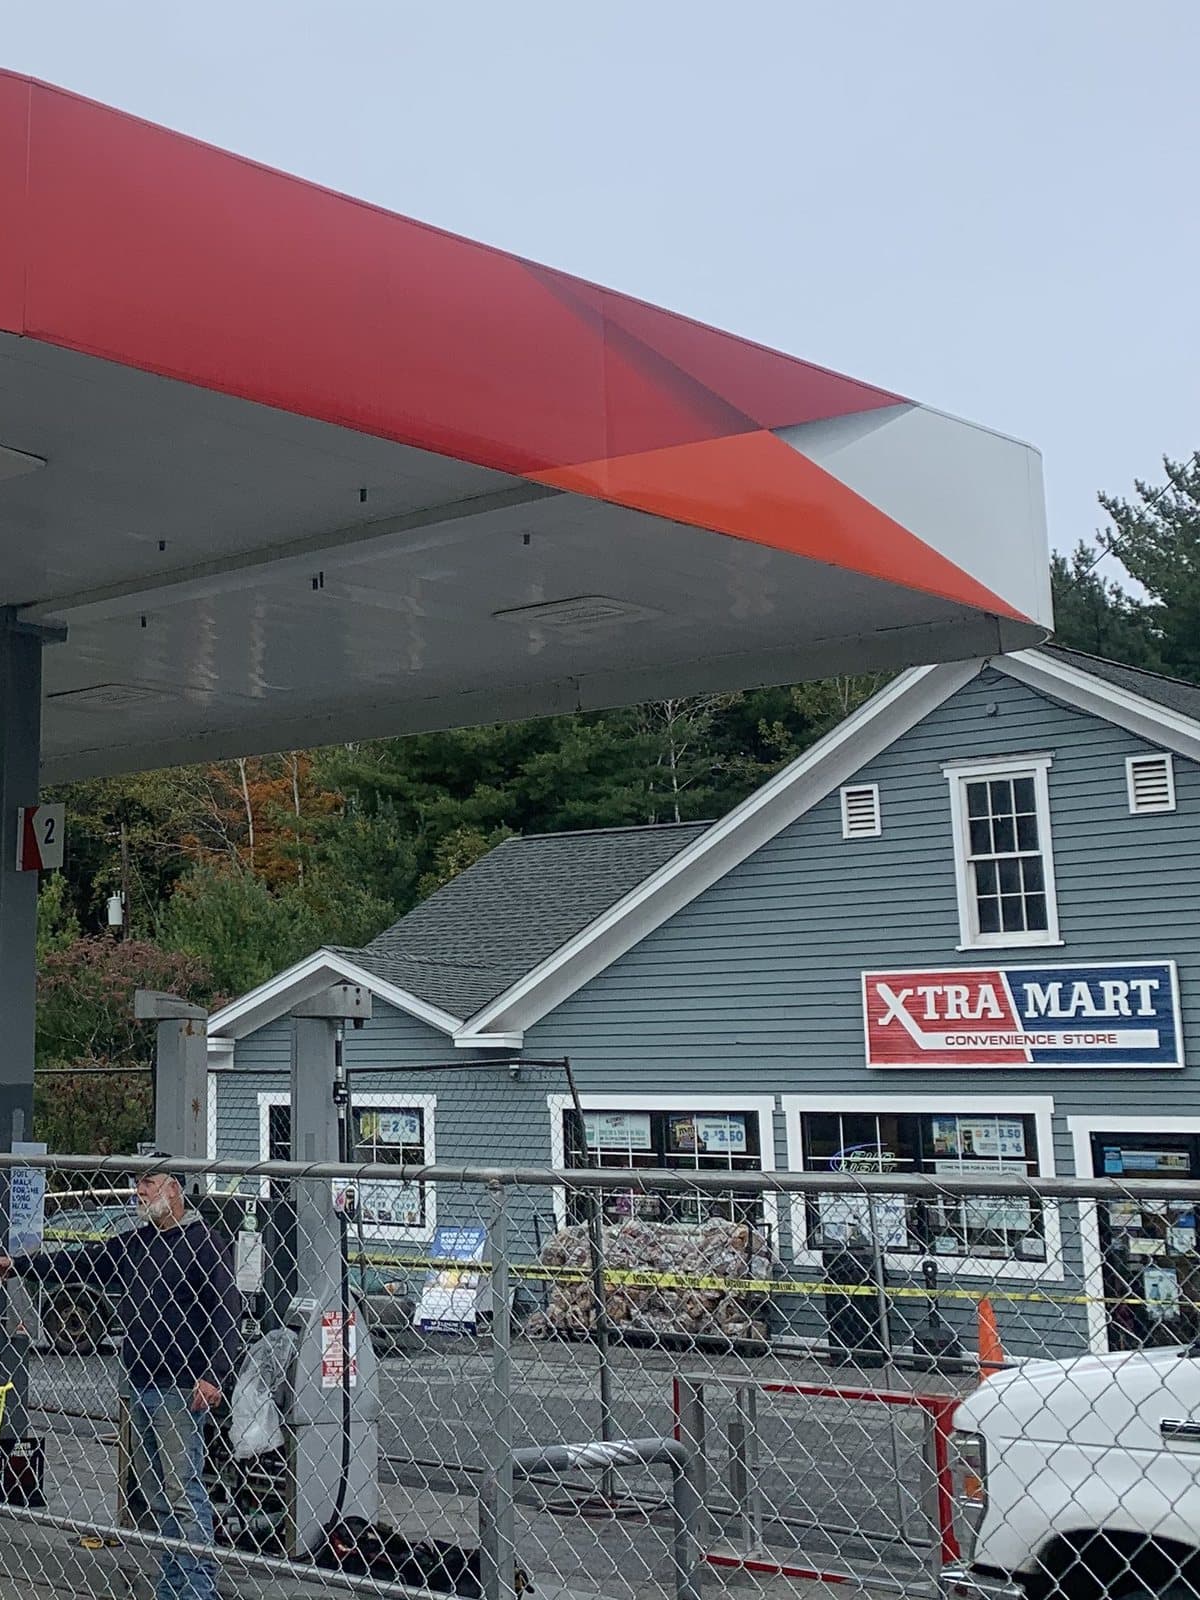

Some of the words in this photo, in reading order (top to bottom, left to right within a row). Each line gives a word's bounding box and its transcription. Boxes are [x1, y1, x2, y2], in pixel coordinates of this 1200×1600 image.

[43, 817, 55, 845] 2
[876, 983, 1005, 1026] XTRA
[1023, 979, 1160, 1018] MART
[944, 1034, 1057, 1046] CONVENIENCE
[1062, 1033, 1118, 1045] STORE
[702, 1130, 709, 1141] 2
[983, 1129, 991, 1138] 2
